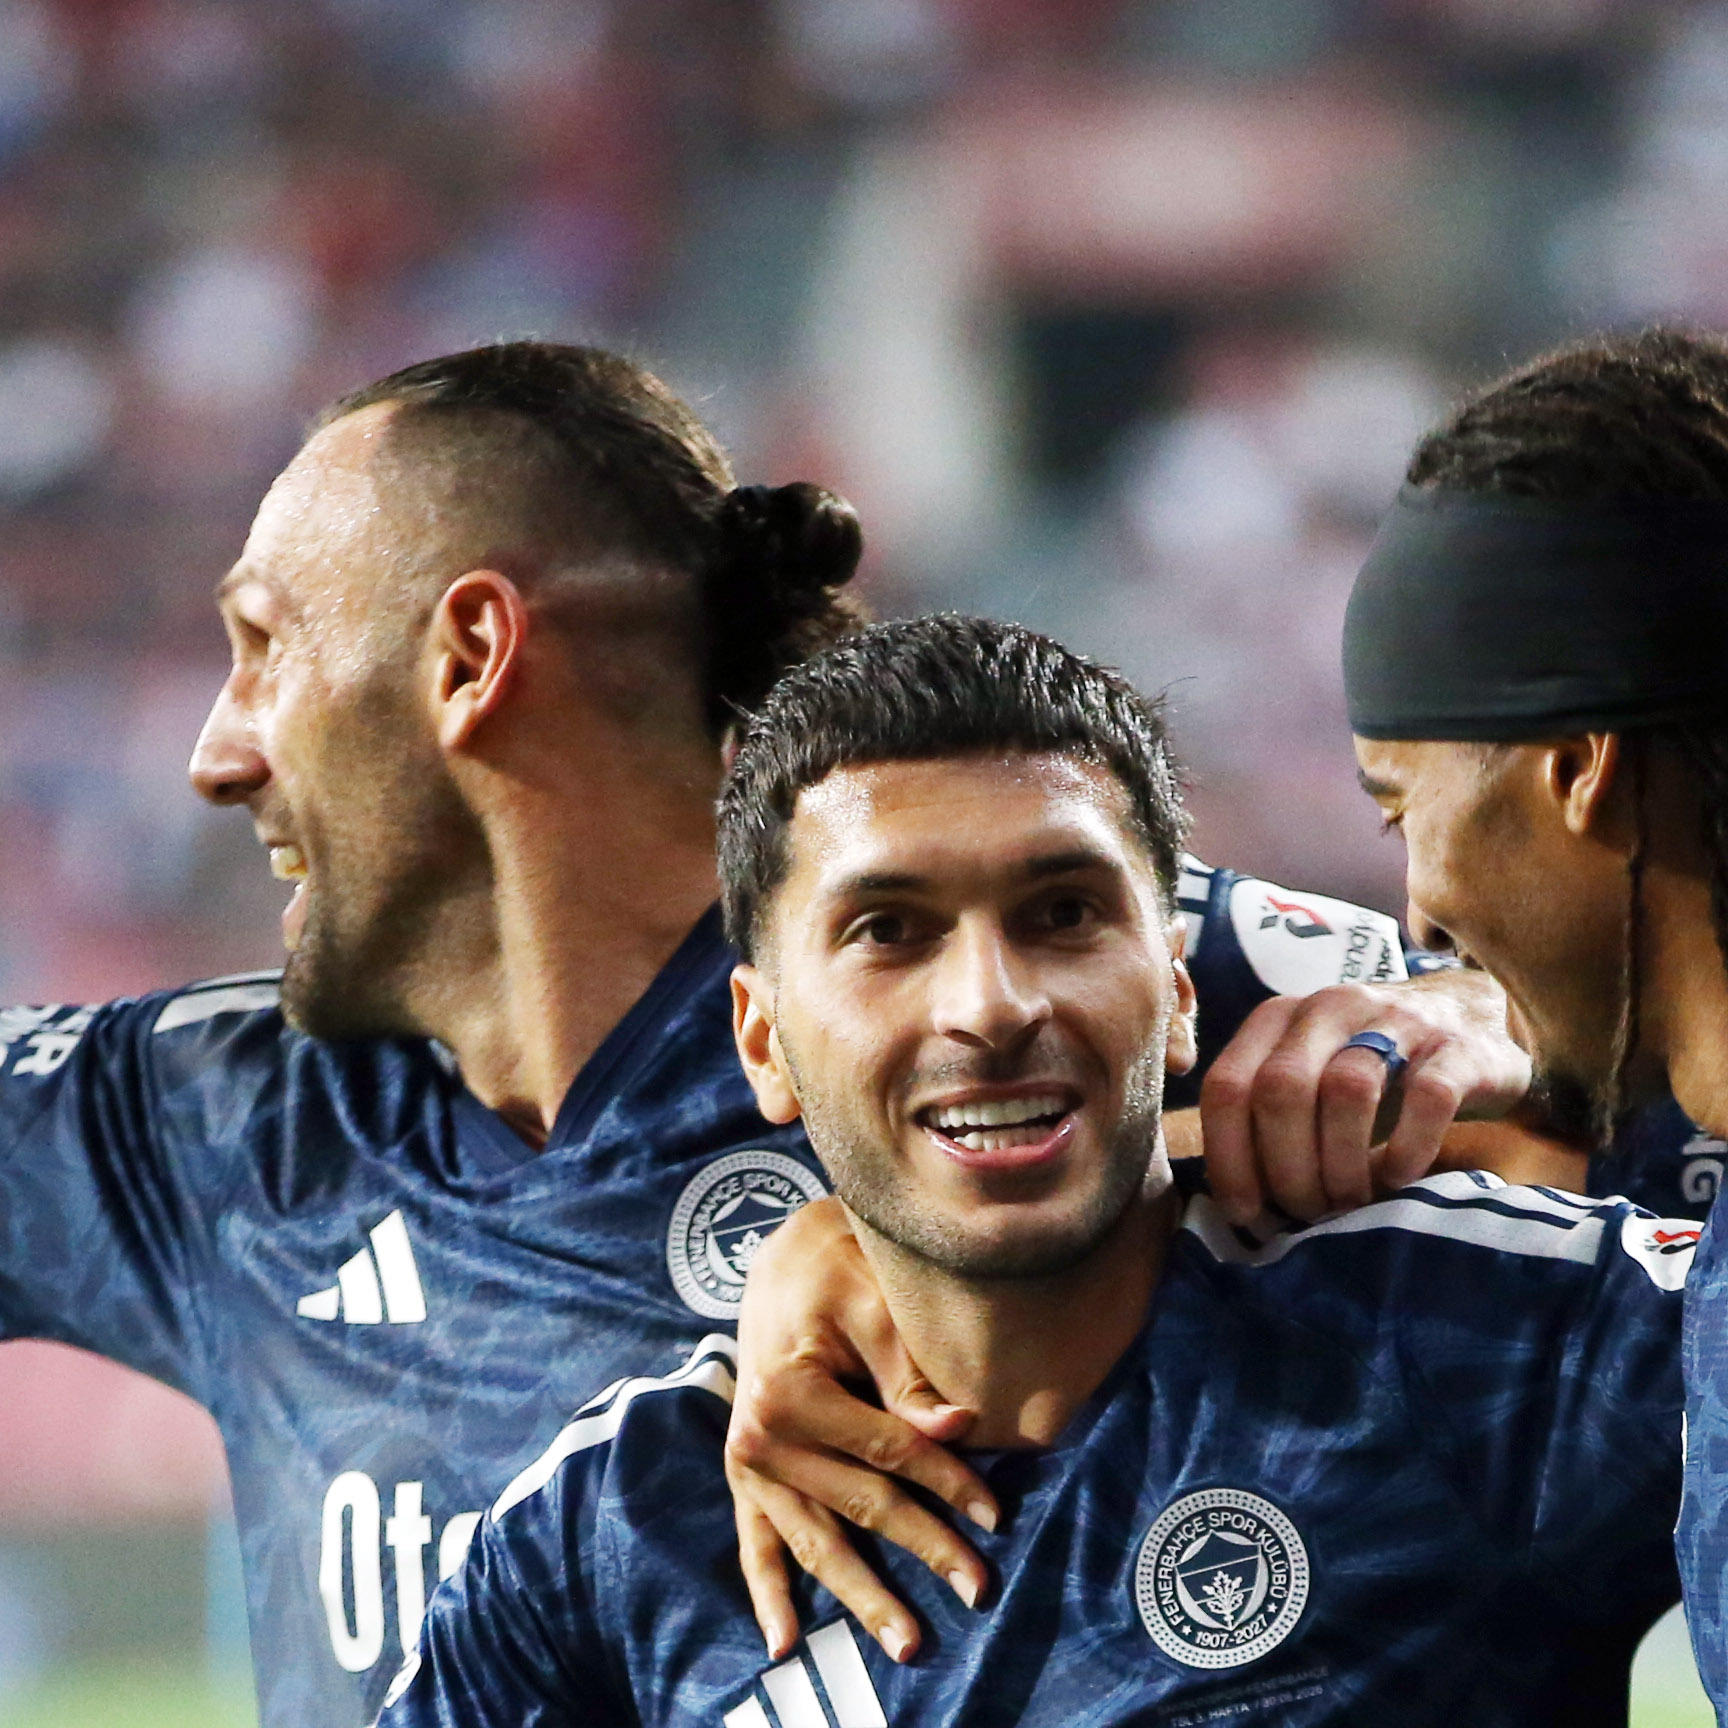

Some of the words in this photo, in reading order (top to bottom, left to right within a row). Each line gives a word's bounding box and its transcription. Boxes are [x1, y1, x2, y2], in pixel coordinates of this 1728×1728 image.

[1157, 1516, 1207, 1626] FENERBAHÇE
[1207, 1511, 1258, 1535] SPOR
[1256, 1528, 1291, 1600] KULÜBÜ
[1194, 1614, 1269, 1648] 1907-2027
